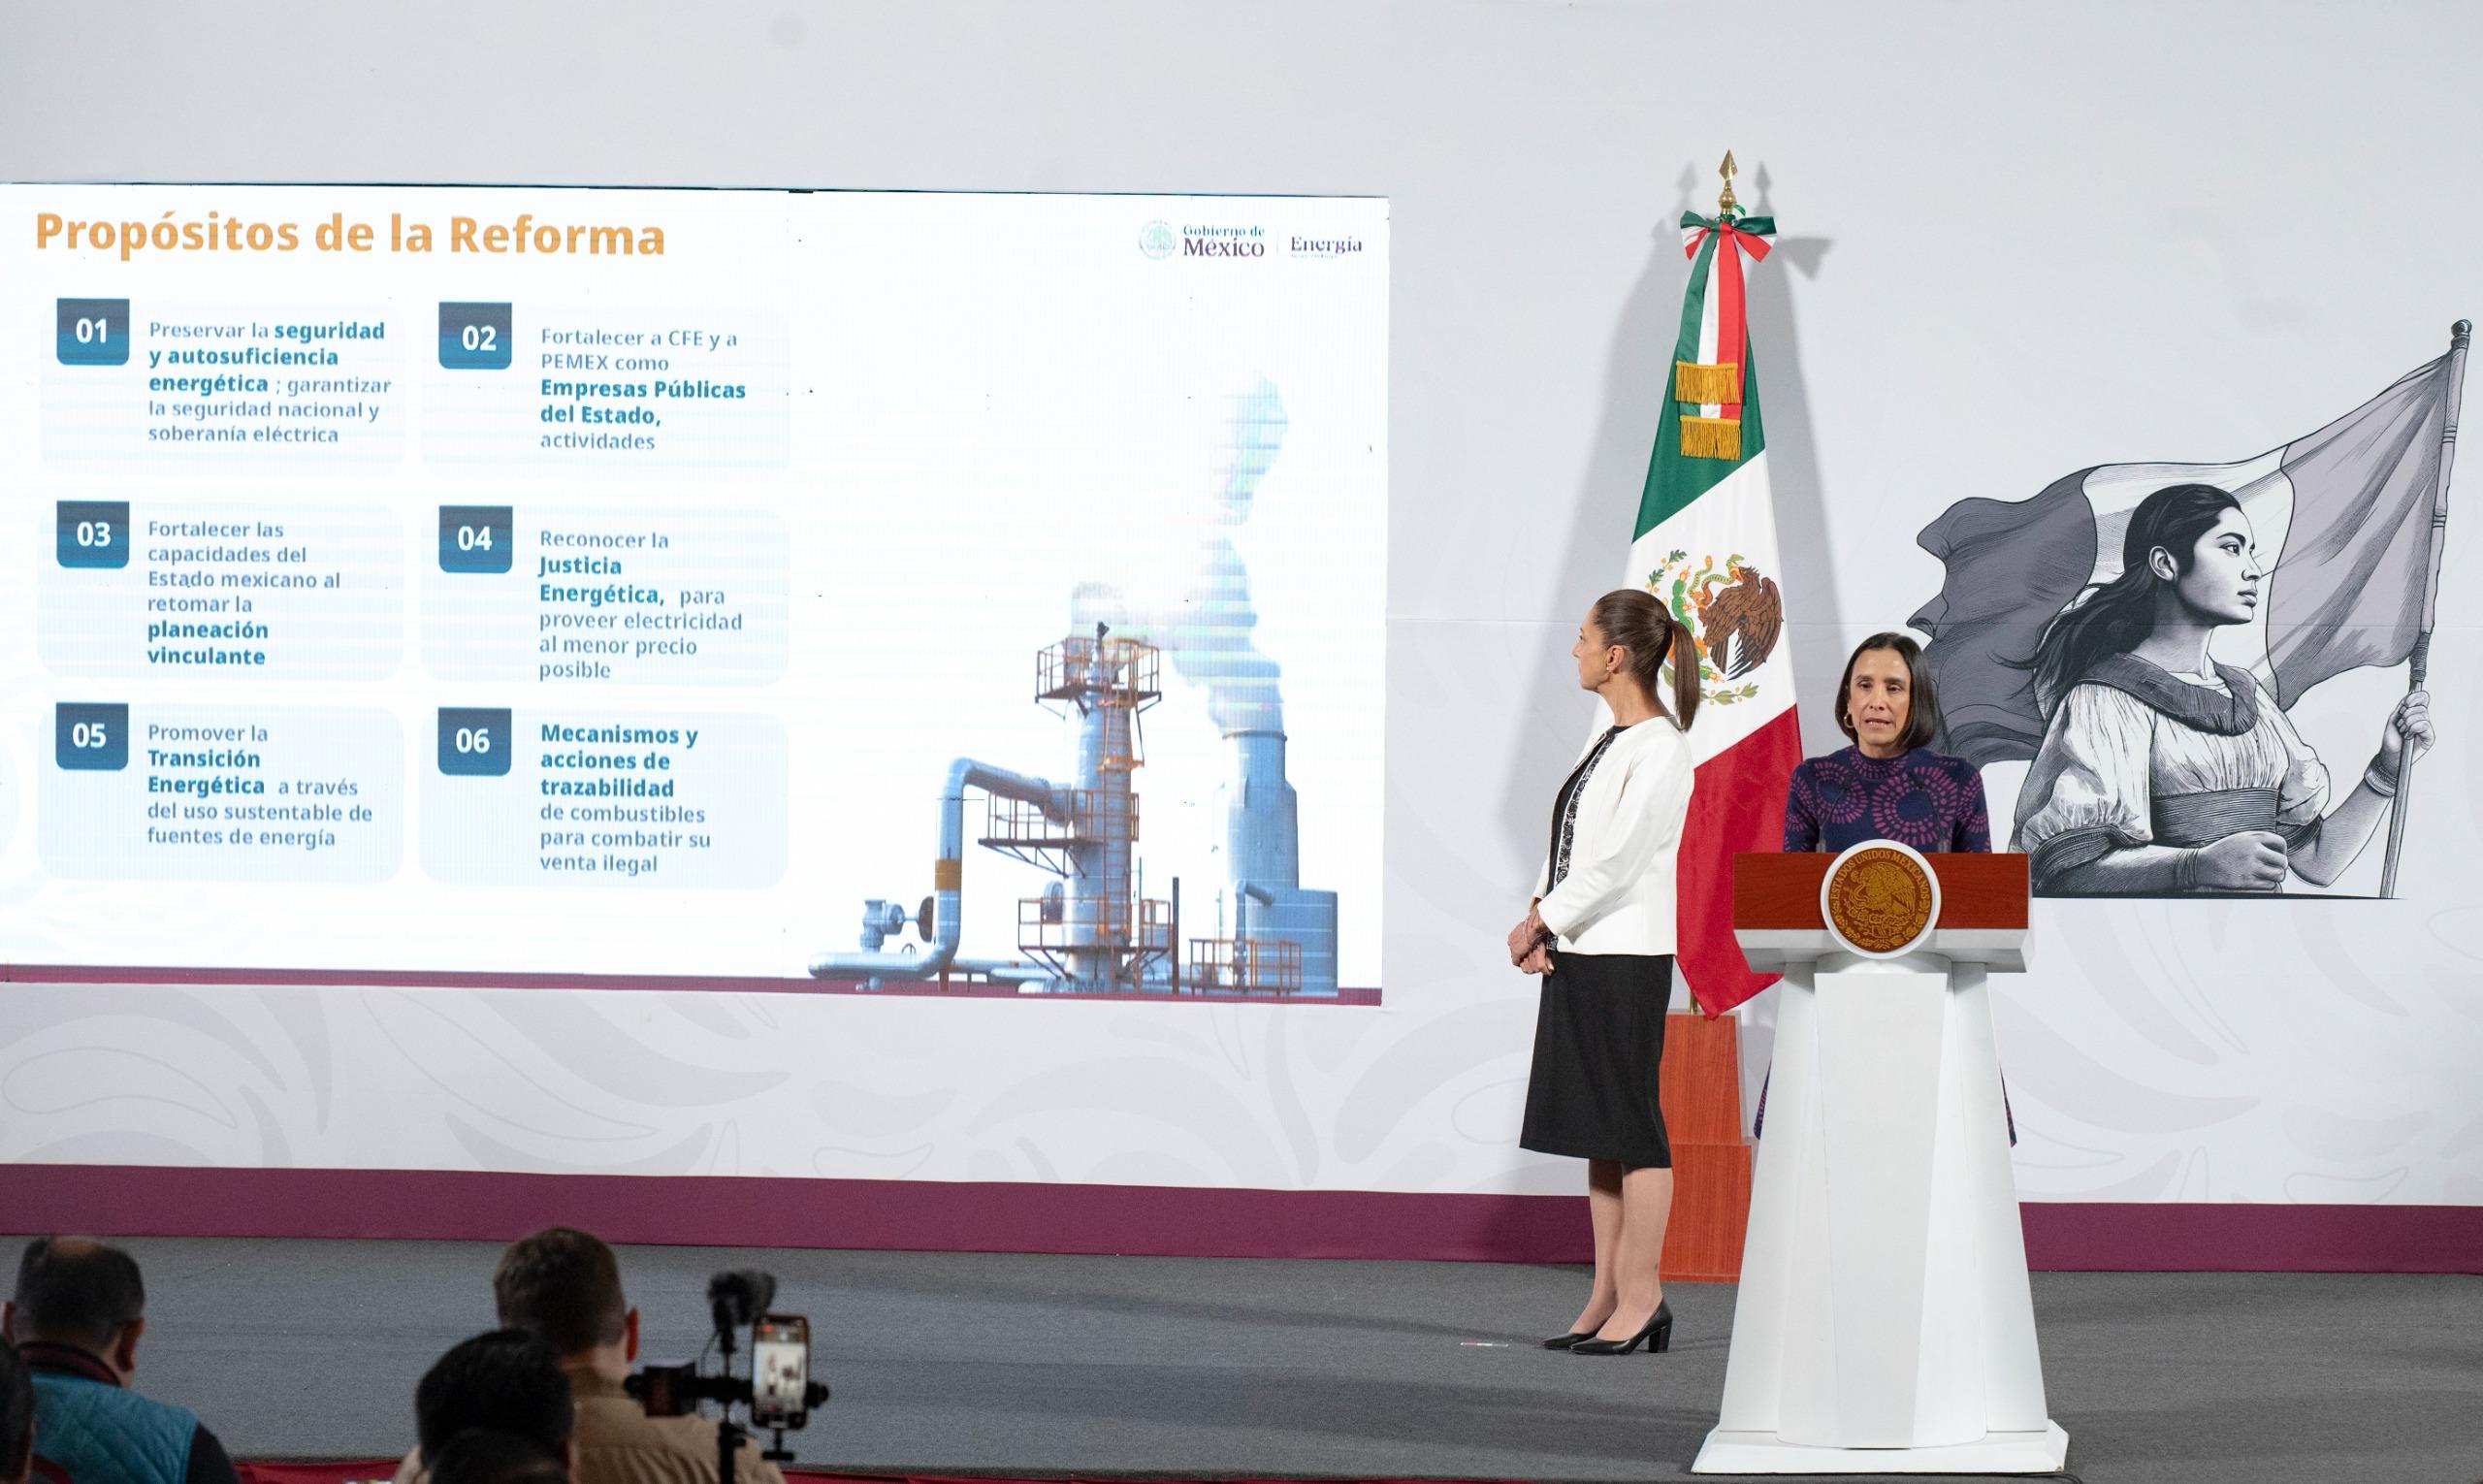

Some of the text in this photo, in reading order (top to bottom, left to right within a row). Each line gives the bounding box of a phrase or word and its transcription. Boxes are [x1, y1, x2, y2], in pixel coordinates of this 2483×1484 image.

[37, 211, 664, 261] Propósitos de la Reforma
[1183, 224, 1265, 237] Gobierno de
[1183, 237, 1265, 257] México
[1291, 236, 1362, 254] Energía
[76, 318, 107, 342] 01
[149, 320, 385, 344] Preservar la seguridad
[463, 325, 496, 350] 02
[541, 328, 737, 352] Fortalecer a CFE y a
[148, 346, 339, 370] y autosuficiencia
[541, 353, 669, 371] PEMEX como
[148, 373, 269, 398] energética
[287, 375, 392, 398] garantizar
[540, 378, 746, 402] Empresas Públicas
[148, 400, 380, 424] la seguridad nacional y
[540, 403, 661, 428] del Estado,
[148, 424, 339, 443] soberanía eléctrica
[540, 431, 656, 450] actividades
[77, 522, 111, 546] 03
[148, 520, 285, 539] Fortalecer las
[458, 526, 493, 550] 04
[540, 530, 669, 549] Reconocer la
[147, 545, 306, 566] capacidades del
[536, 555, 622, 579] Justicia
[148, 569, 340, 589] Estado mexicano al
[147, 595, 252, 613] retomar la
[540, 583, 726, 609] Energética, para
[147, 619, 269, 643] planeación
[539, 611, 742, 632] proveer electricidad
[146, 645, 266, 665] vinculante
[539, 634, 697, 660] al menor precio
[539, 660, 611, 683] posible
[73, 724, 107, 747] 05
[148, 724, 269, 742] Promover la
[456, 728, 490, 752] 06
[541, 724, 699, 750] Mecanismos y
[146, 748, 261, 768] Transición
[540, 749, 670, 770] acciones de
[147, 775, 358, 799] Energética a través
[540, 777, 674, 798] trazabilidad
[147, 801, 372, 823] del uso sustentable de
[539, 802, 705, 823] de combustibles
[147, 826, 336, 852] fuentes de energía
[540, 829, 711, 851] para combatir su
[539, 854, 658, 877] venta ilegal
[1830, 850, 1931, 901] ESTADOS UNIDOS MEXICANOS
